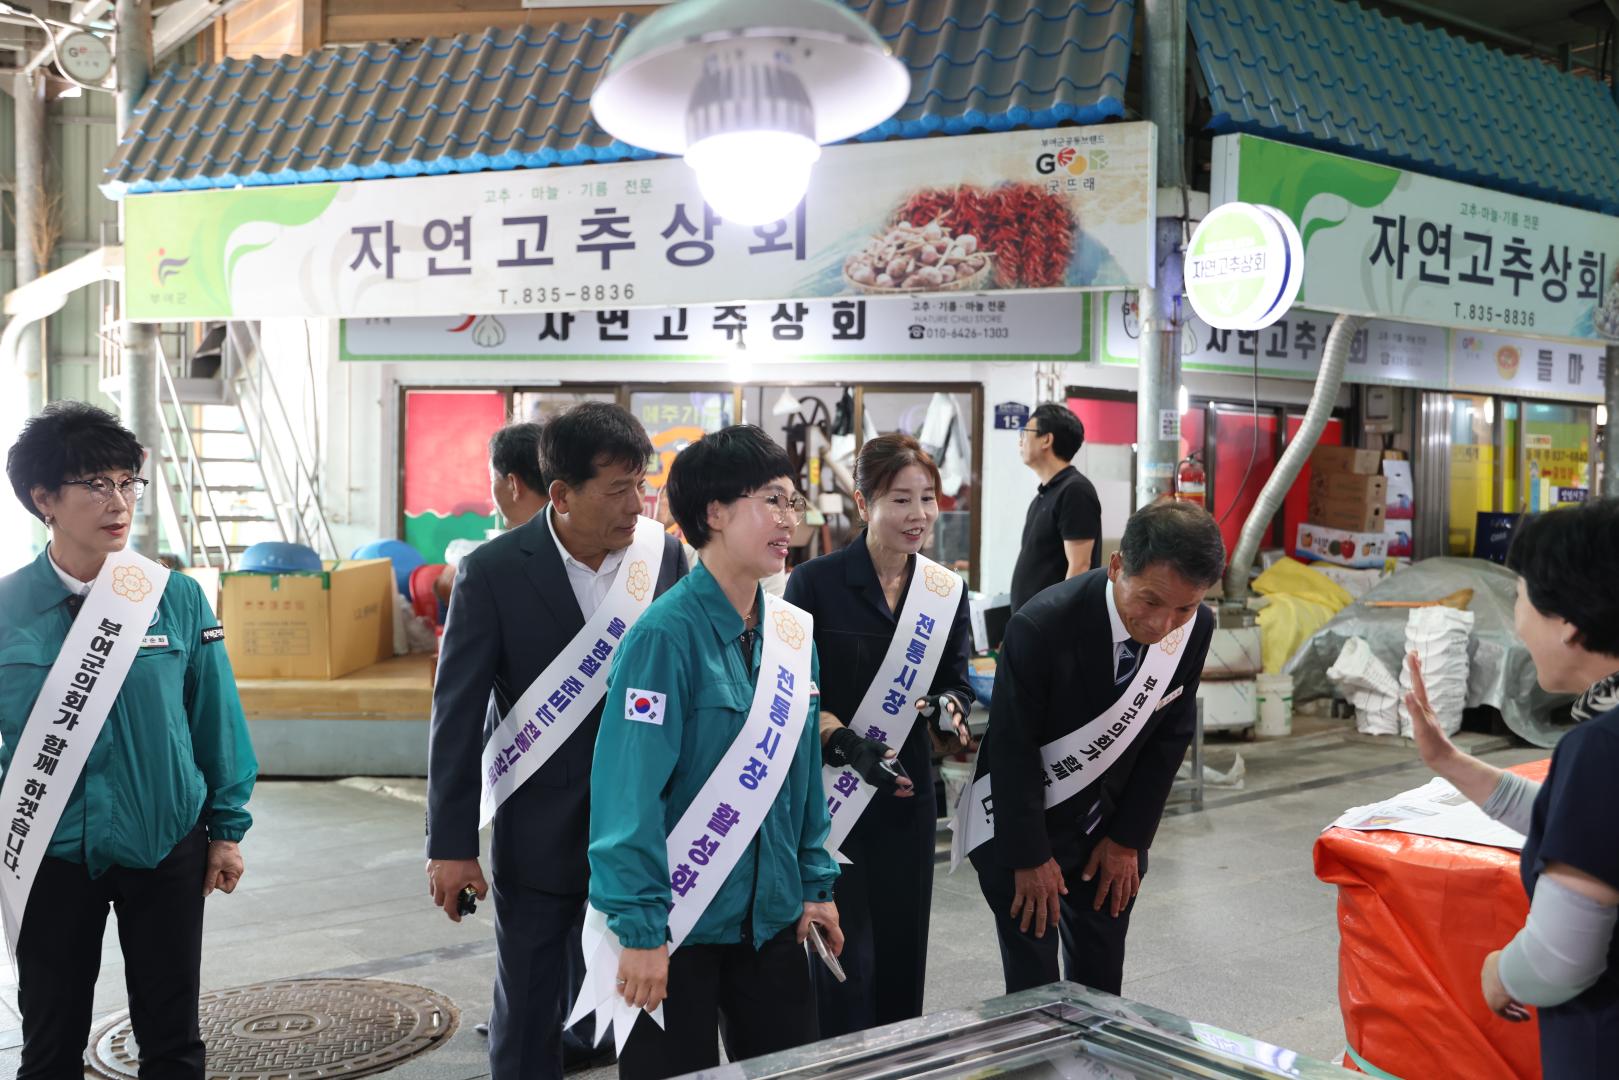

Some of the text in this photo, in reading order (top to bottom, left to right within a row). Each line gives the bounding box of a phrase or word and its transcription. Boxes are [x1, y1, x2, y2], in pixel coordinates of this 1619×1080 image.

[485, 178, 653, 203] 고추 마늘 기름 전문
[1048, 177, 1095, 193] 굿뜨래
[1523, 214, 1540, 231] 전문
[1192, 252, 1266, 279] 자연고추상회
[1369, 214, 1606, 308] 자연고추상회
[499, 283, 635, 305] T.835-8836
[1454, 302, 1535, 327] T.835-8836
[1206, 320, 1369, 364] 자연고추회
[1003, 415, 1020, 429] 15
[578, 638, 613, 679] 명절
[882, 612, 936, 716] 전통시장
[535, 675, 585, 728] 준비는
[738, 664, 795, 791] 전통시장
[1050, 675, 1158, 781] 부여군의회가 함께
[4, 618, 122, 880] 부여군의회가 함께 하겠습니다.
